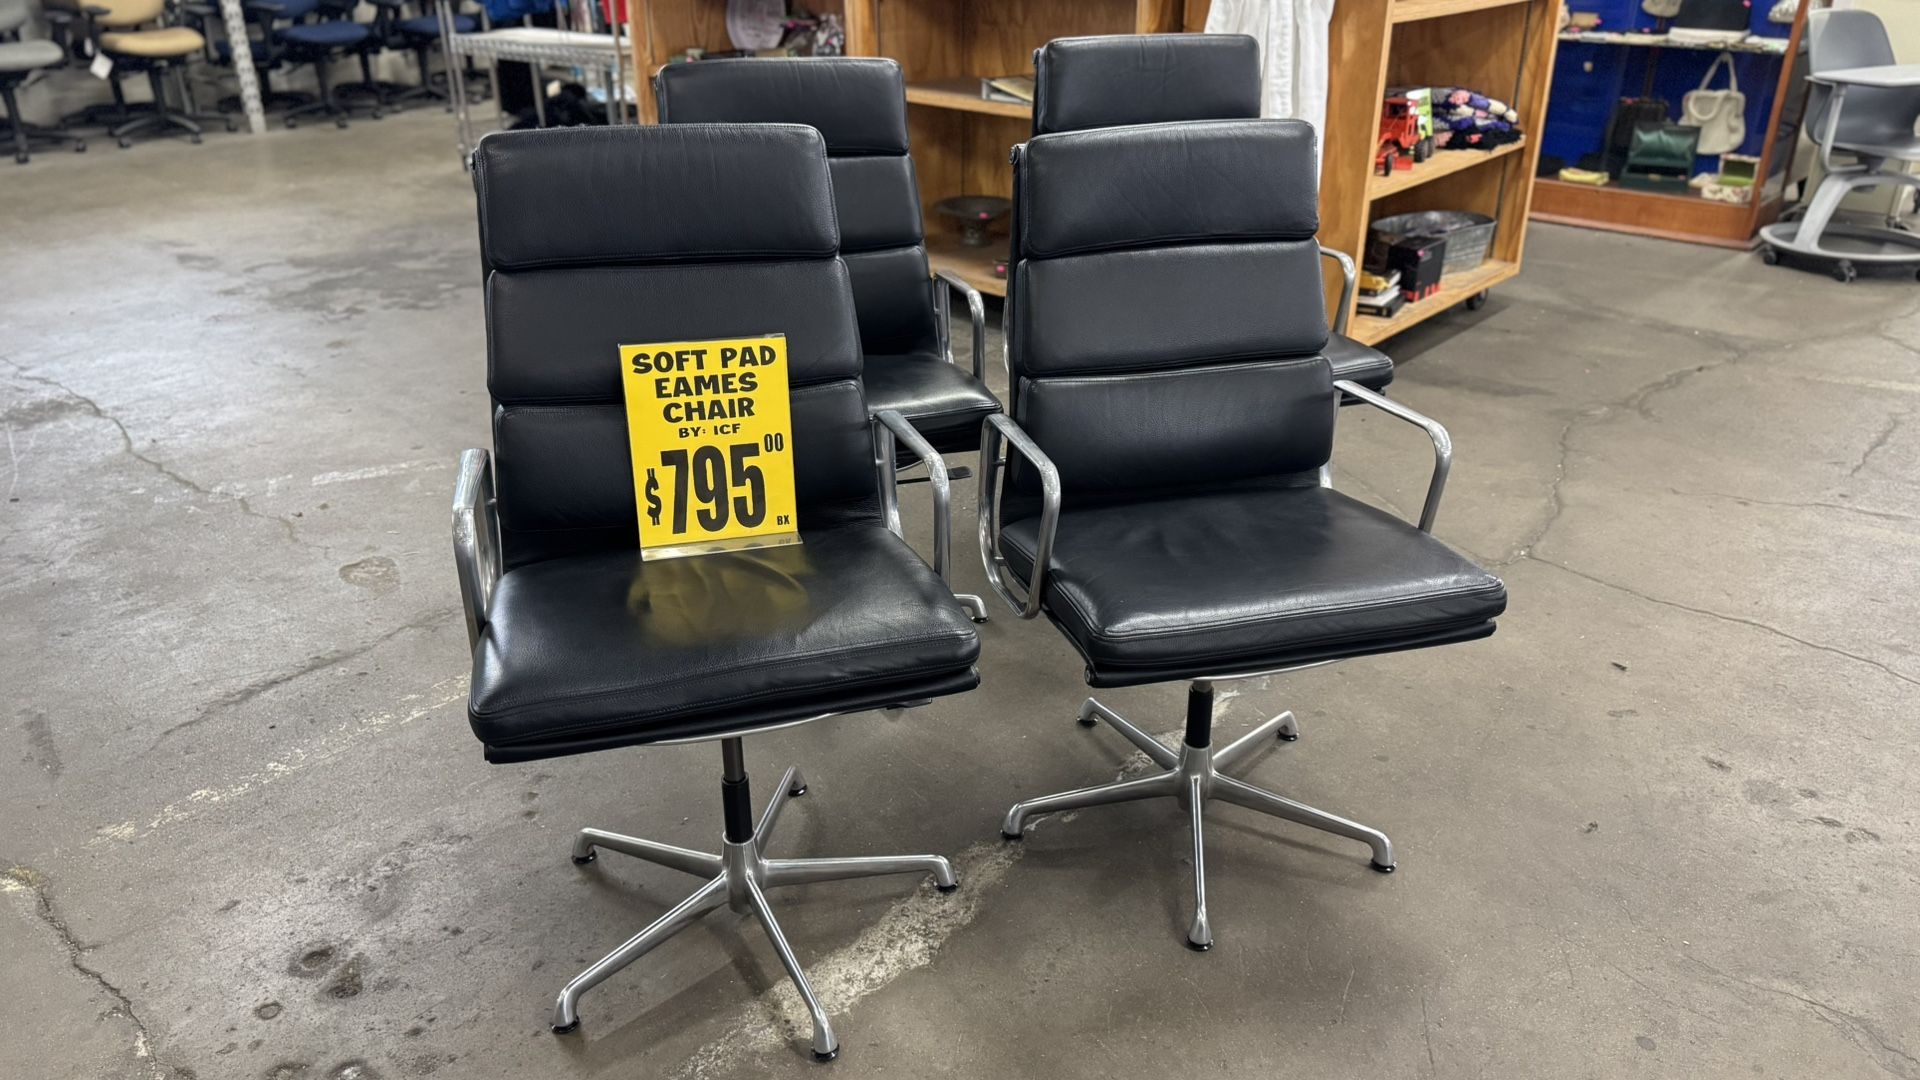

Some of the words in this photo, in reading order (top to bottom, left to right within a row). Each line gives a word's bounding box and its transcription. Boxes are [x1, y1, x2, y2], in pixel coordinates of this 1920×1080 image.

[632, 350, 707, 374] SOFT
[720, 346, 776, 368] PAD
[655, 372, 758, 398] EAMES
[663, 398, 755, 423] CHAIR
[678, 428, 706, 438] BY:
[713, 423, 741, 435] ICF
[777, 515, 790, 526] BX
